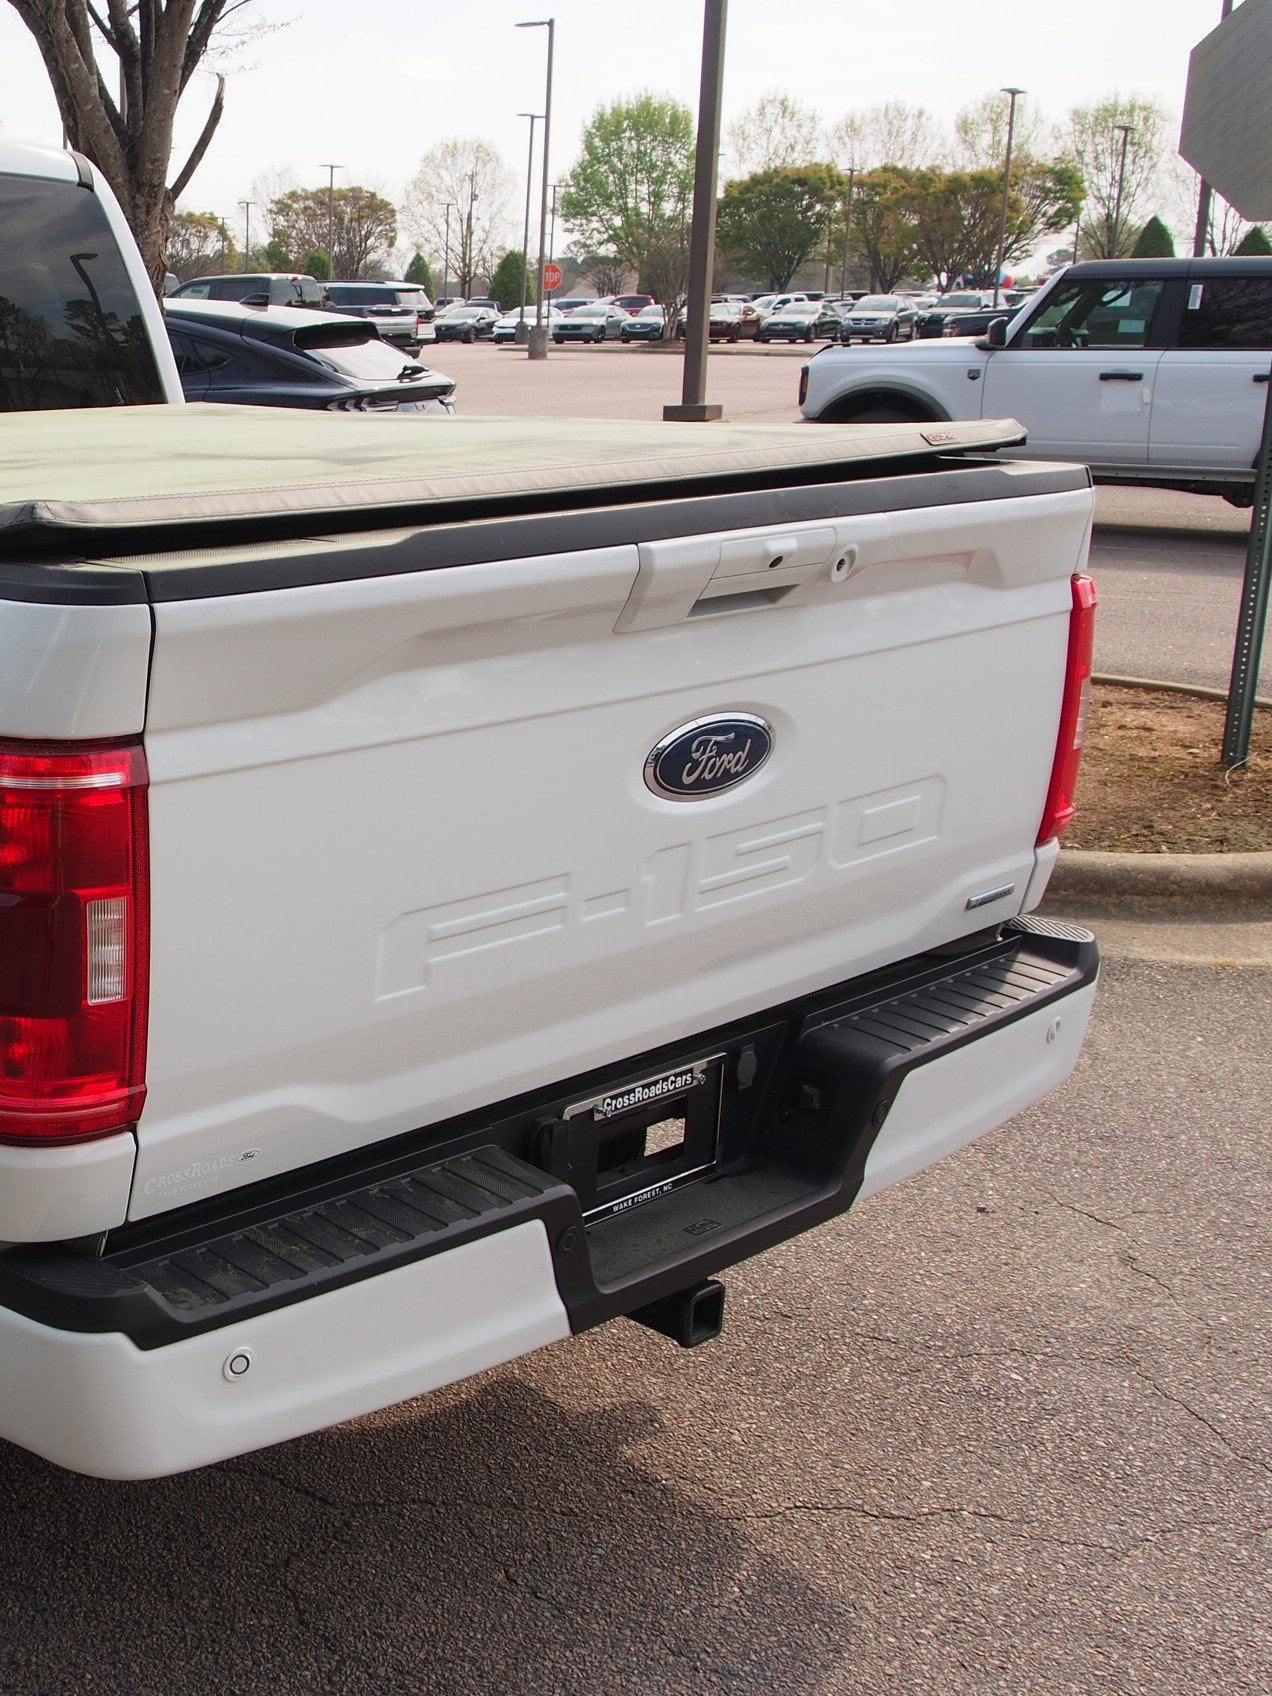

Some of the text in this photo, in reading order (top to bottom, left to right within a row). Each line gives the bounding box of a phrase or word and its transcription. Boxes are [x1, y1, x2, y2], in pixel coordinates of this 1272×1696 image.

[545, 272, 560, 282] TOP
[682, 732, 752, 784] Ford
[374, 773, 948, 1001] F-150
[603, 1072, 693, 1112] CrossRoadsCars
[612, 1183, 673, 1212] WAKE FOREST, NC
